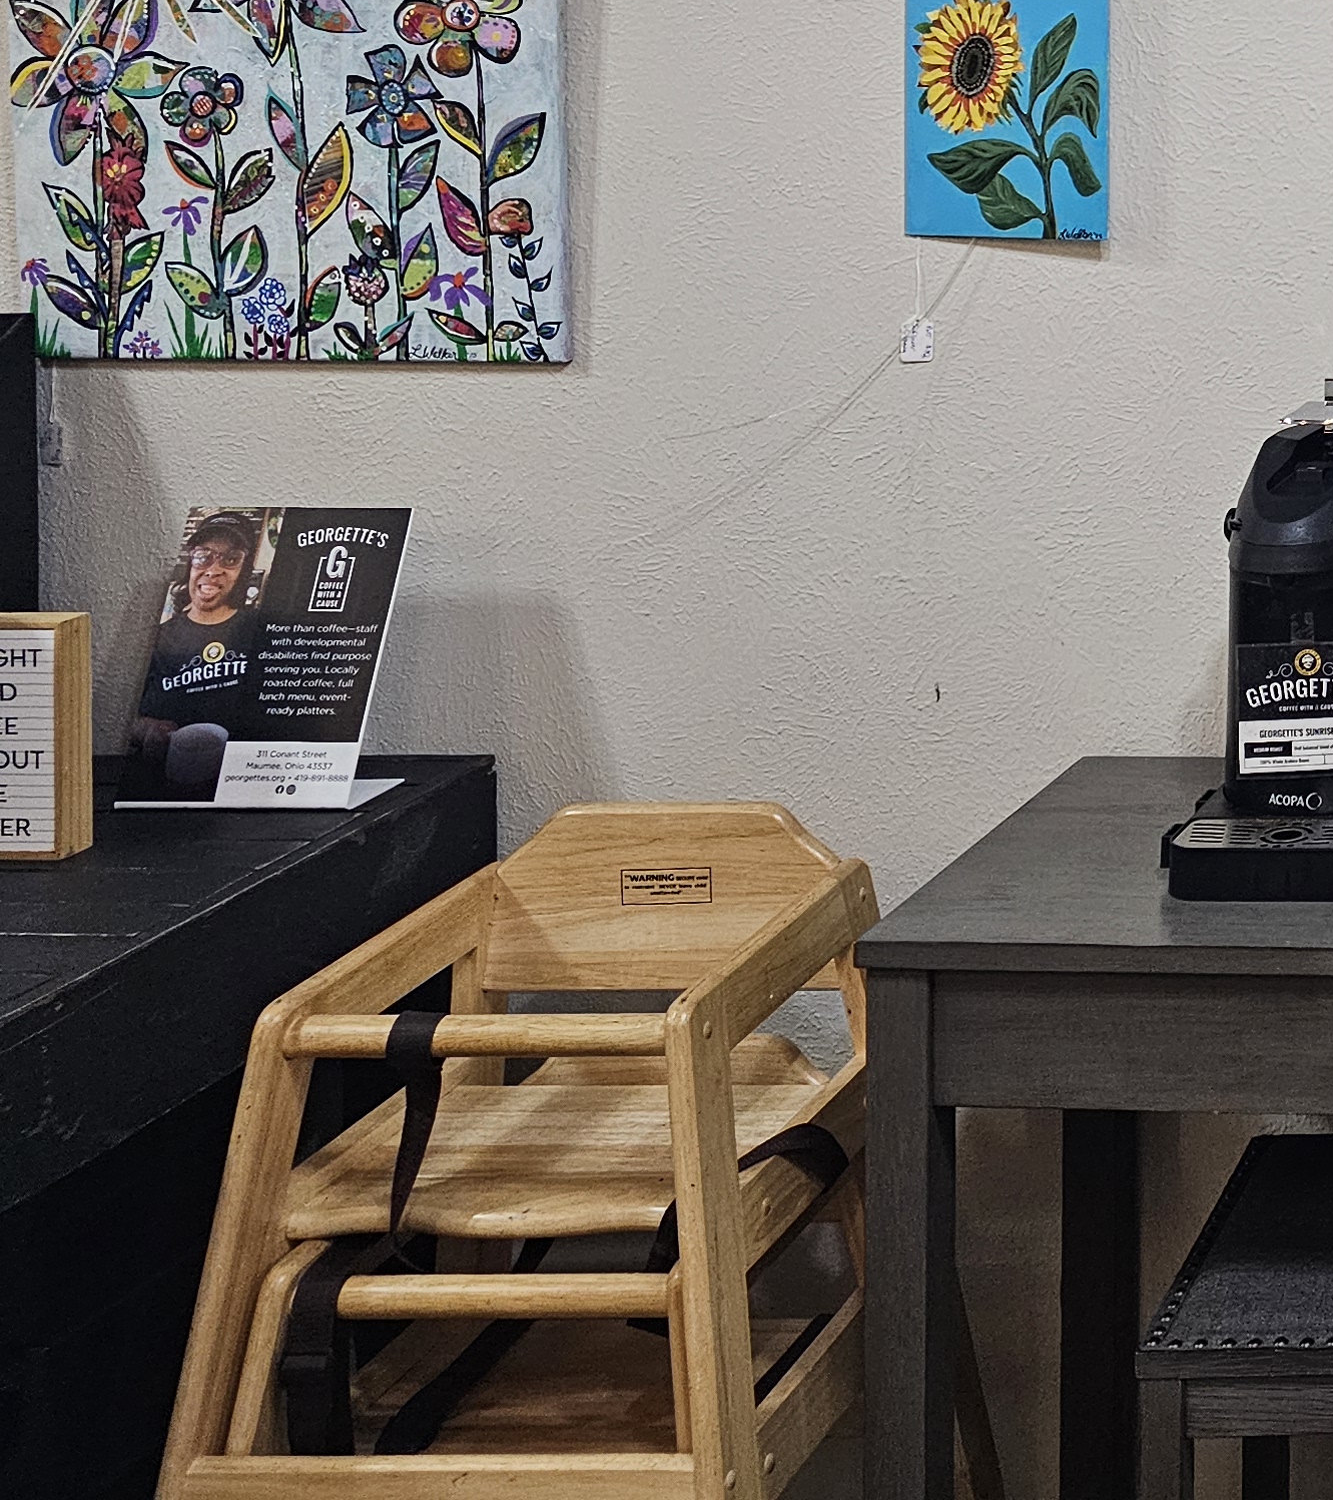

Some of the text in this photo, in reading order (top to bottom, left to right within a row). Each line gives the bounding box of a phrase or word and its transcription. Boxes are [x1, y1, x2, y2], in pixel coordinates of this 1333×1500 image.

[297, 527, 390, 548] GEORGETTE'S
[326, 546, 349, 578] G
[265, 624, 377, 633] More than coffee—staff
[270, 638, 365, 649] with developmental
[257, 652, 372, 662] disabilities find purpose
[263, 665, 359, 676] serving you. Locally
[262, 679, 353, 688] roasted coffee, full
[258, 692, 285, 700] lunch
[318, 692, 351, 700] event-
[265, 706, 336, 717] ready platters.
[1260, 728, 1303, 738] GEORGETTE'S
[1306, 727, 1333, 736] SUNRISE
[255, 750, 268, 758] 311
[269, 750, 299, 758] Conant
[244, 762, 332, 771] Maumee, Ohio 43537
[223, 773, 286, 783] georgettes.org
